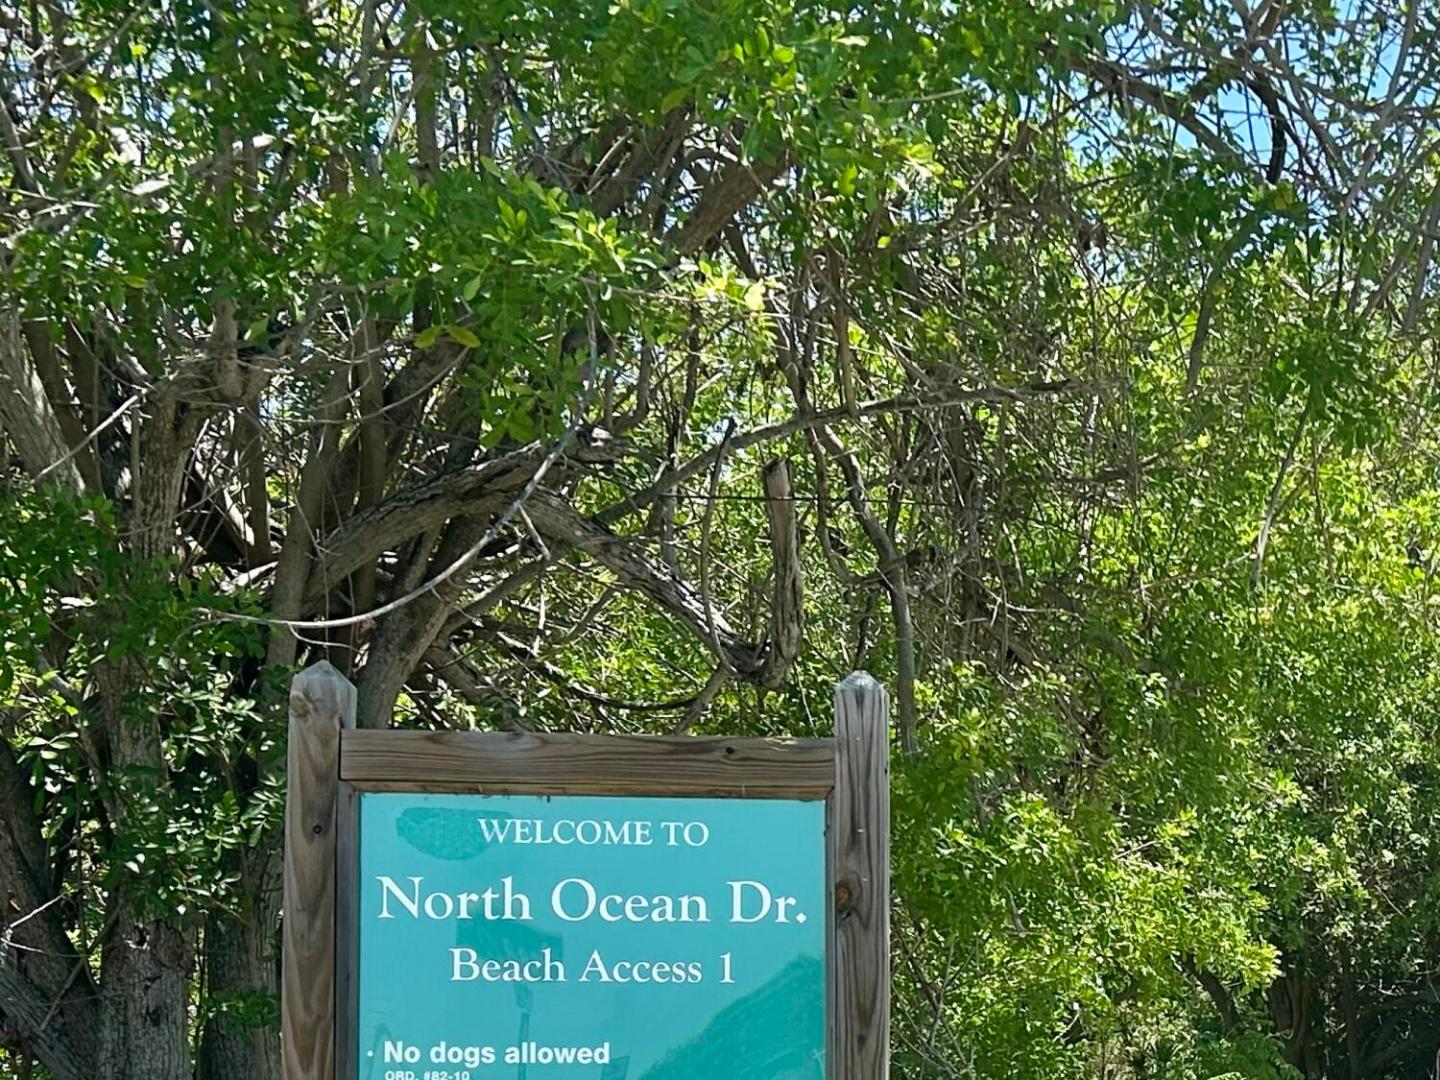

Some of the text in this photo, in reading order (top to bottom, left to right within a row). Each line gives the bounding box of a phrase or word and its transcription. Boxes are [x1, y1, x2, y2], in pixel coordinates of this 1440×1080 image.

[479, 818, 709, 845] WELCOME TO
[376, 876, 807, 923] North Ocean Dr.
[450, 948, 736, 983] Beach Access 1
[384, 1042, 610, 1071] No dogs allowed
